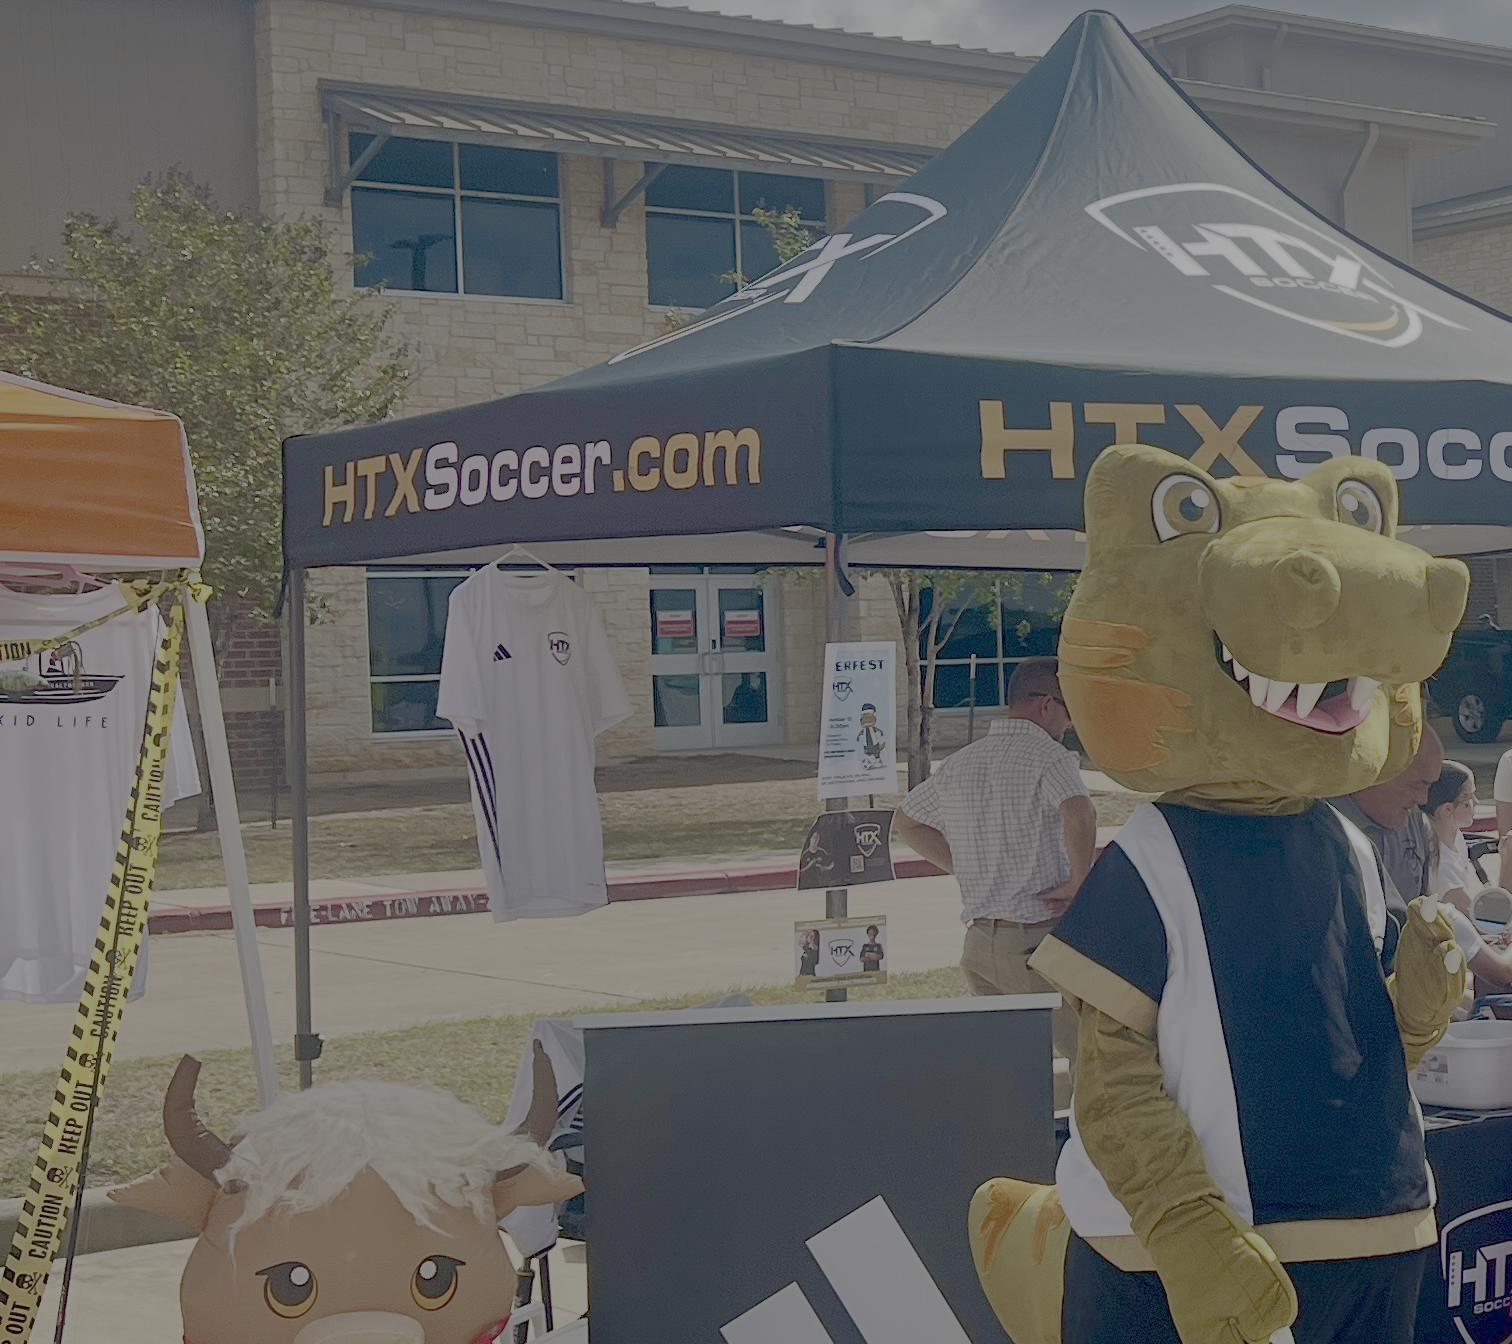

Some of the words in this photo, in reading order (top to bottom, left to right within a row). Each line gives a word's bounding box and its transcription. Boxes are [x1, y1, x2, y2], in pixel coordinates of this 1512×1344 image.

[321, 425, 762, 527] HTXSoccer.com
[835, 659, 885, 672] ERFEST
[57, 715, 109, 729] LIFE
[856, 830, 882, 846] HTX
[123, 862, 149, 896] OUT
[118, 899, 140, 937] KEEP
[830, 944, 855, 958] HTX
[69, 1079, 95, 1113] OUT
[57, 1116, 84, 1156] KEEP
[28, 1193, 64, 1260] CAUTION
[5, 1301, 31, 1336] OUT
